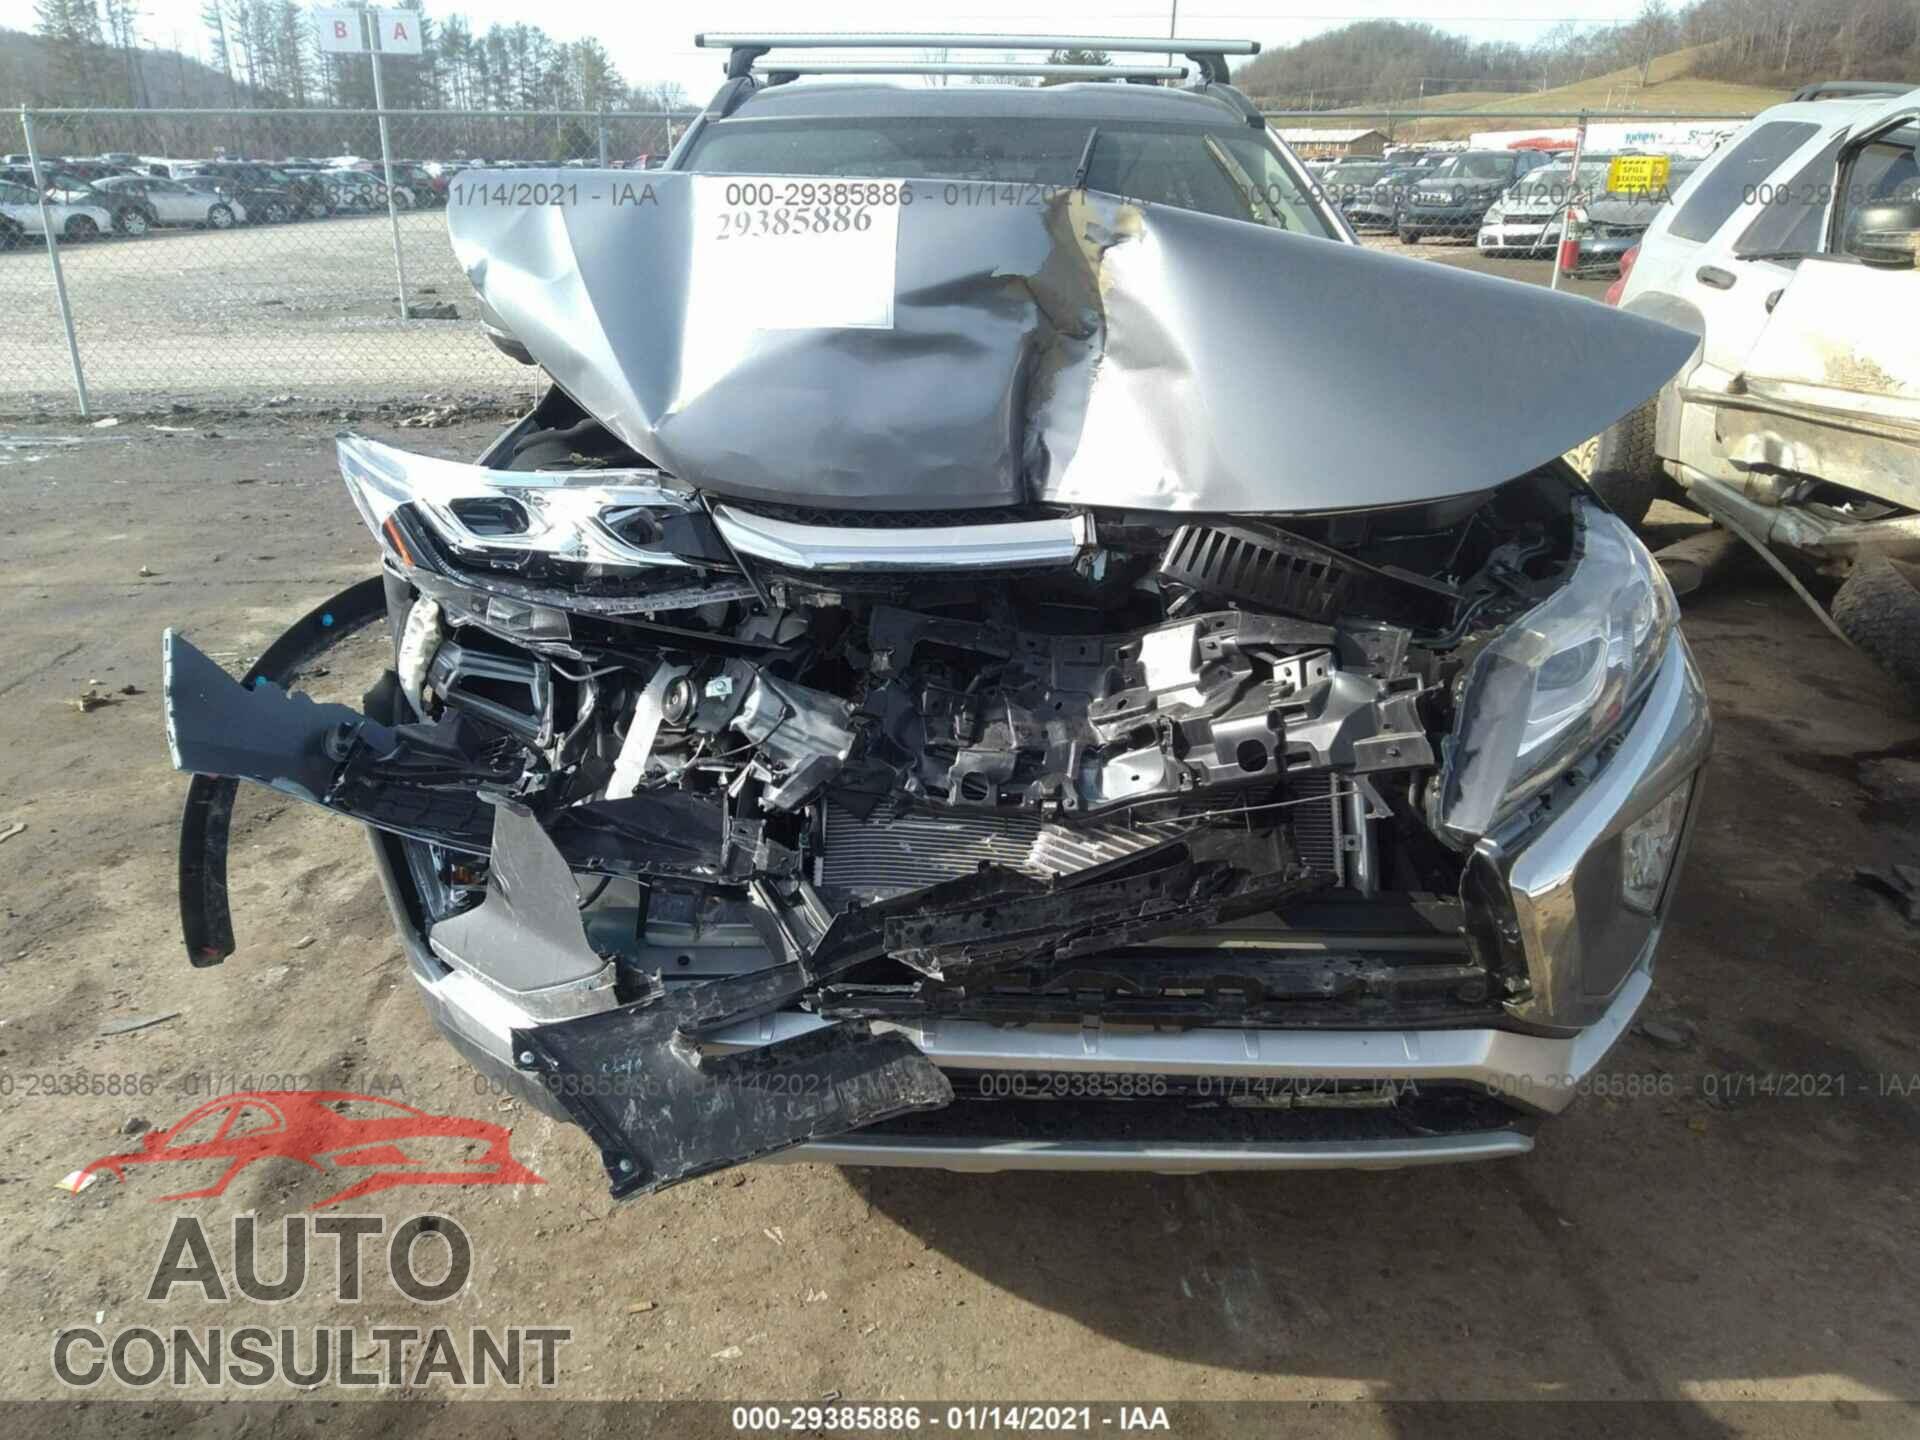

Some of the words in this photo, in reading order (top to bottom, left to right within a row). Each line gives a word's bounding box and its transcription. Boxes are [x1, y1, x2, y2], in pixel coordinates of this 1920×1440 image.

[334, 20, 347, 38] B
[394, 22, 408, 40] A
[716, 205, 872, 240] 29385886
